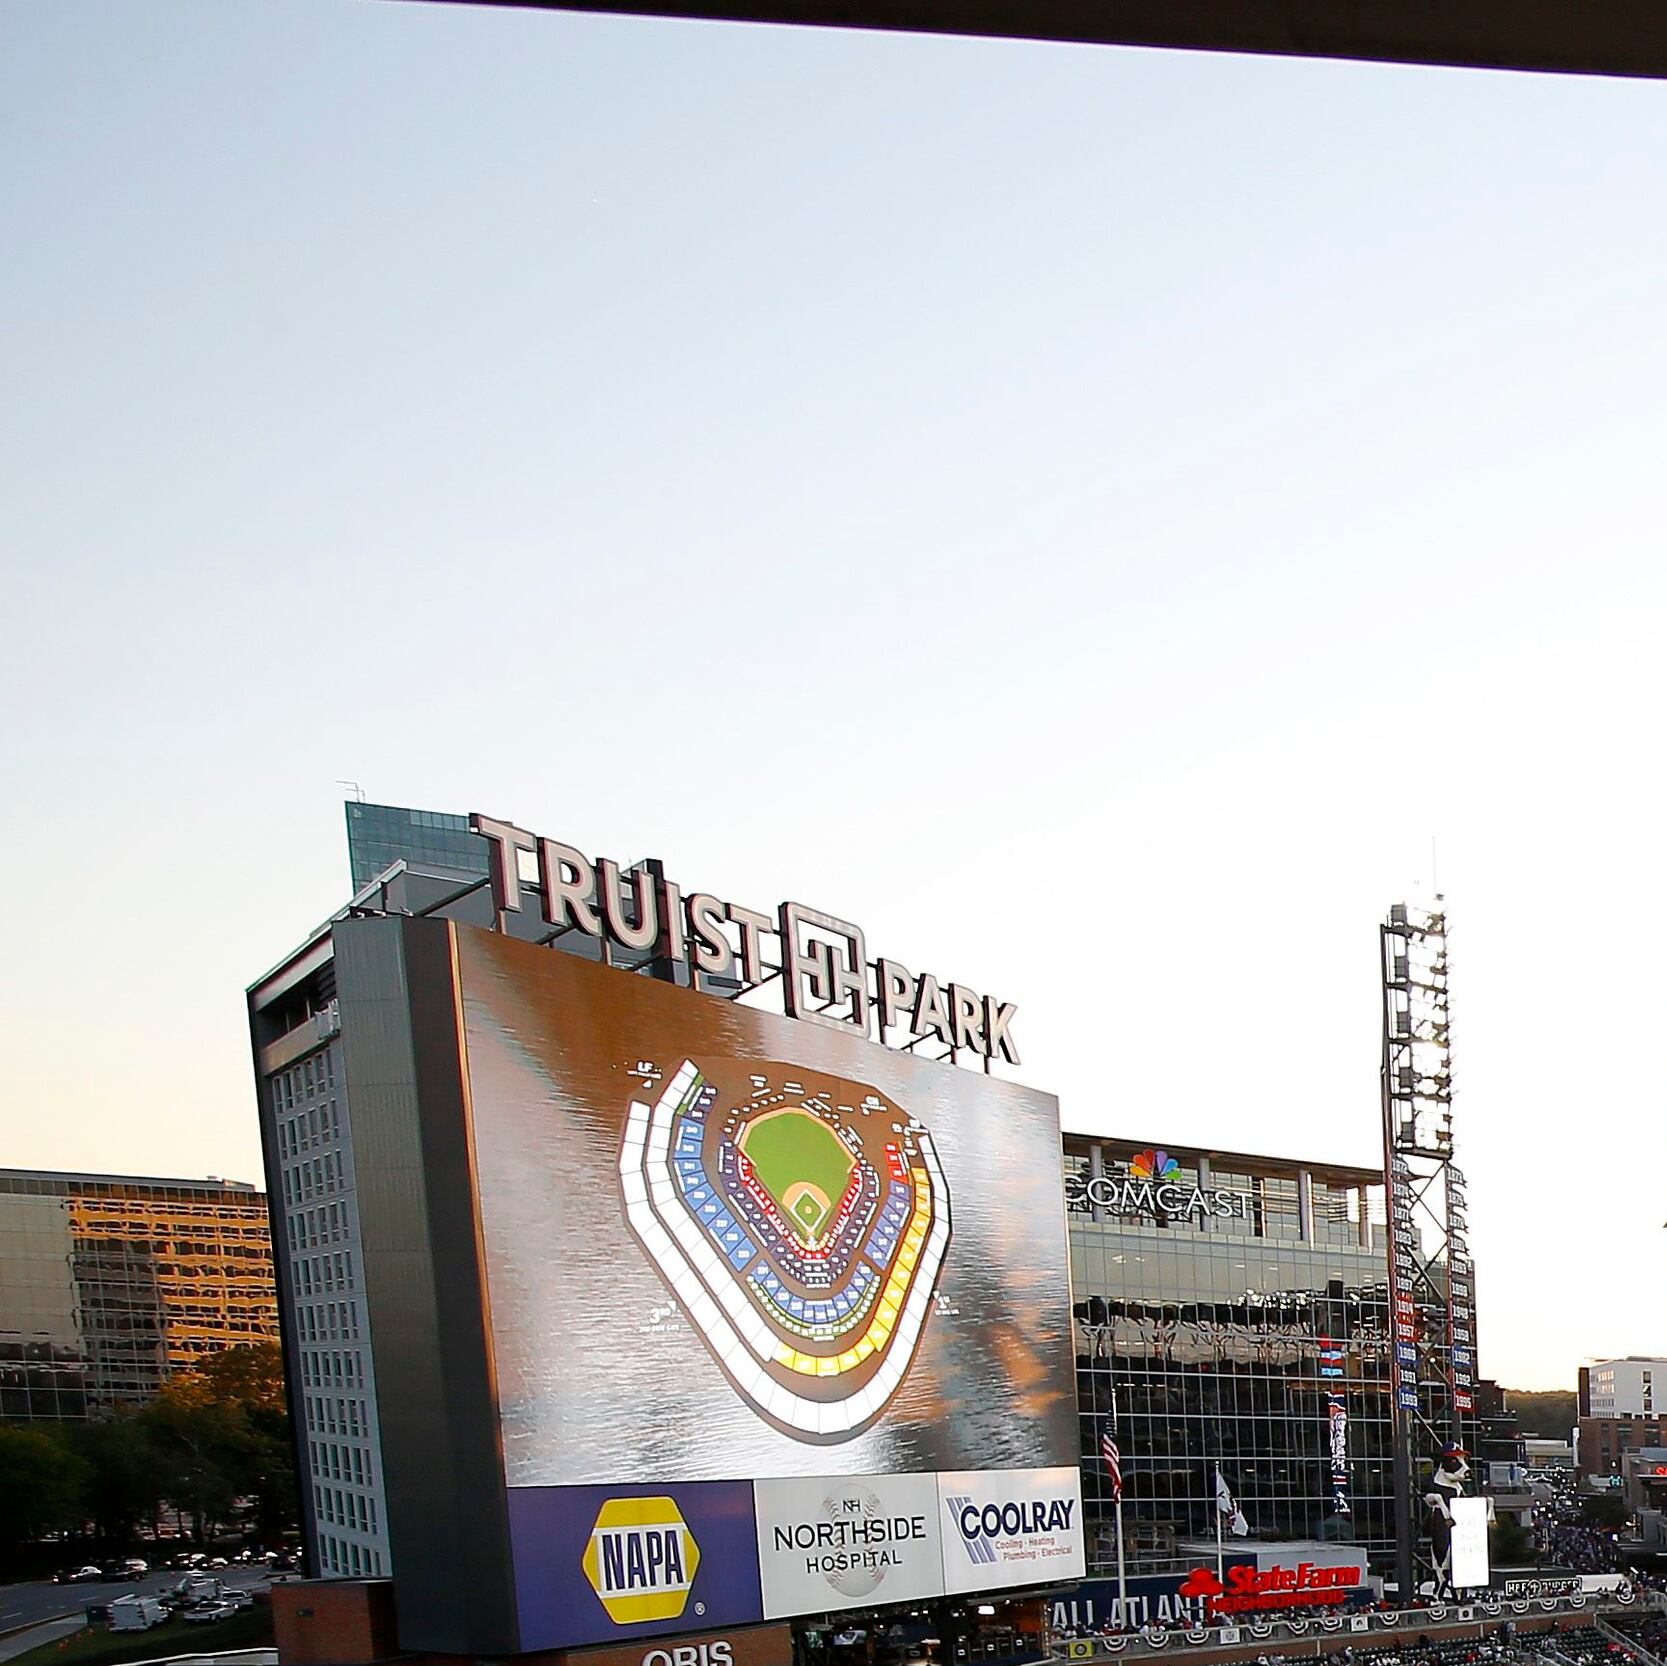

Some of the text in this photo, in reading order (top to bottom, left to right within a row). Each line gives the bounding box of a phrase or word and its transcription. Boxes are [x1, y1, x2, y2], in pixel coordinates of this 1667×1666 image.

[469, 813, 1021, 1065] TRUIST PARK
[1065, 1175, 1252, 1219] COMCAST
[774, 1516, 926, 1551] NORTHSIDE
[960, 1497, 1075, 1539] COOLRAY
[601, 1530, 684, 1591] NAPA
[806, 1549, 902, 1574] HOSPITAL
[995, 1537, 1055, 1550] Cooling Heating
[1003, 1545, 1073, 1561] Plumbing Electrical
